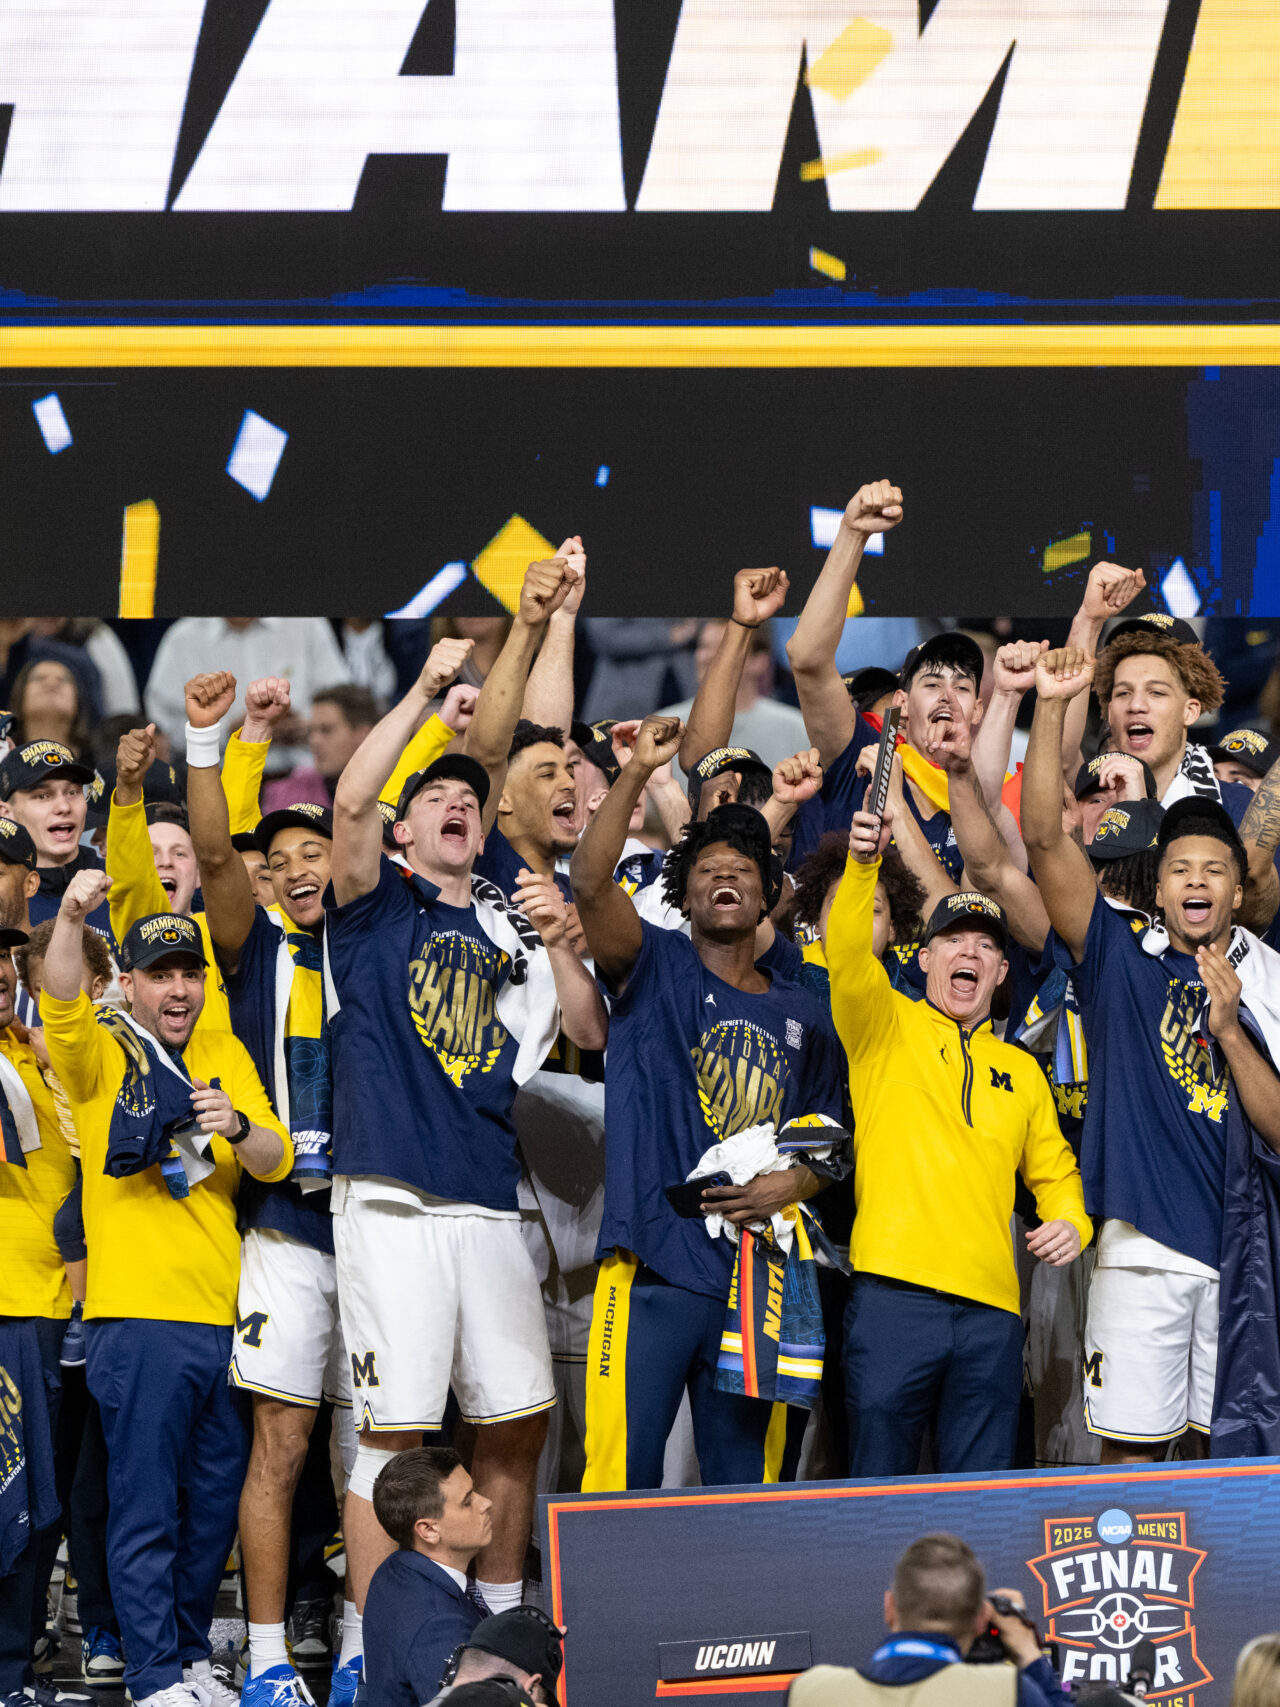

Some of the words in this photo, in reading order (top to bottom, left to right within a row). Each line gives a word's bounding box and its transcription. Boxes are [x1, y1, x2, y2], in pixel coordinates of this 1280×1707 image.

[21, 742, 74, 764] CHAMPIONS
[46, 755, 60, 763] M
[698, 748, 751, 777] CHAMPIONS
[948, 896, 1002, 919] CHAMPIONS
[969, 902, 985, 913] M
[140, 918, 196, 941] CHAMPIONS
[164, 930, 178, 940] M
[989, 1066, 1014, 1093] M
[1055, 1086, 1084, 1119] M
[1188, 1085, 1227, 1123] M
[291, 1130, 331, 1145] ENDS
[236, 1310, 269, 1348] M
[599, 1285, 617, 1378] MICHIGAN
[351, 1351, 380, 1388] M
[1083, 1350, 1104, 1388] M
[1054, 1526, 1093, 1546] 2026
[1101, 1524, 1132, 1536] NCAA
[1137, 1522, 1177, 1539] MEN'S
[1050, 1549, 1179, 1599] FINAL
[694, 1640, 777, 1671] UCONN
